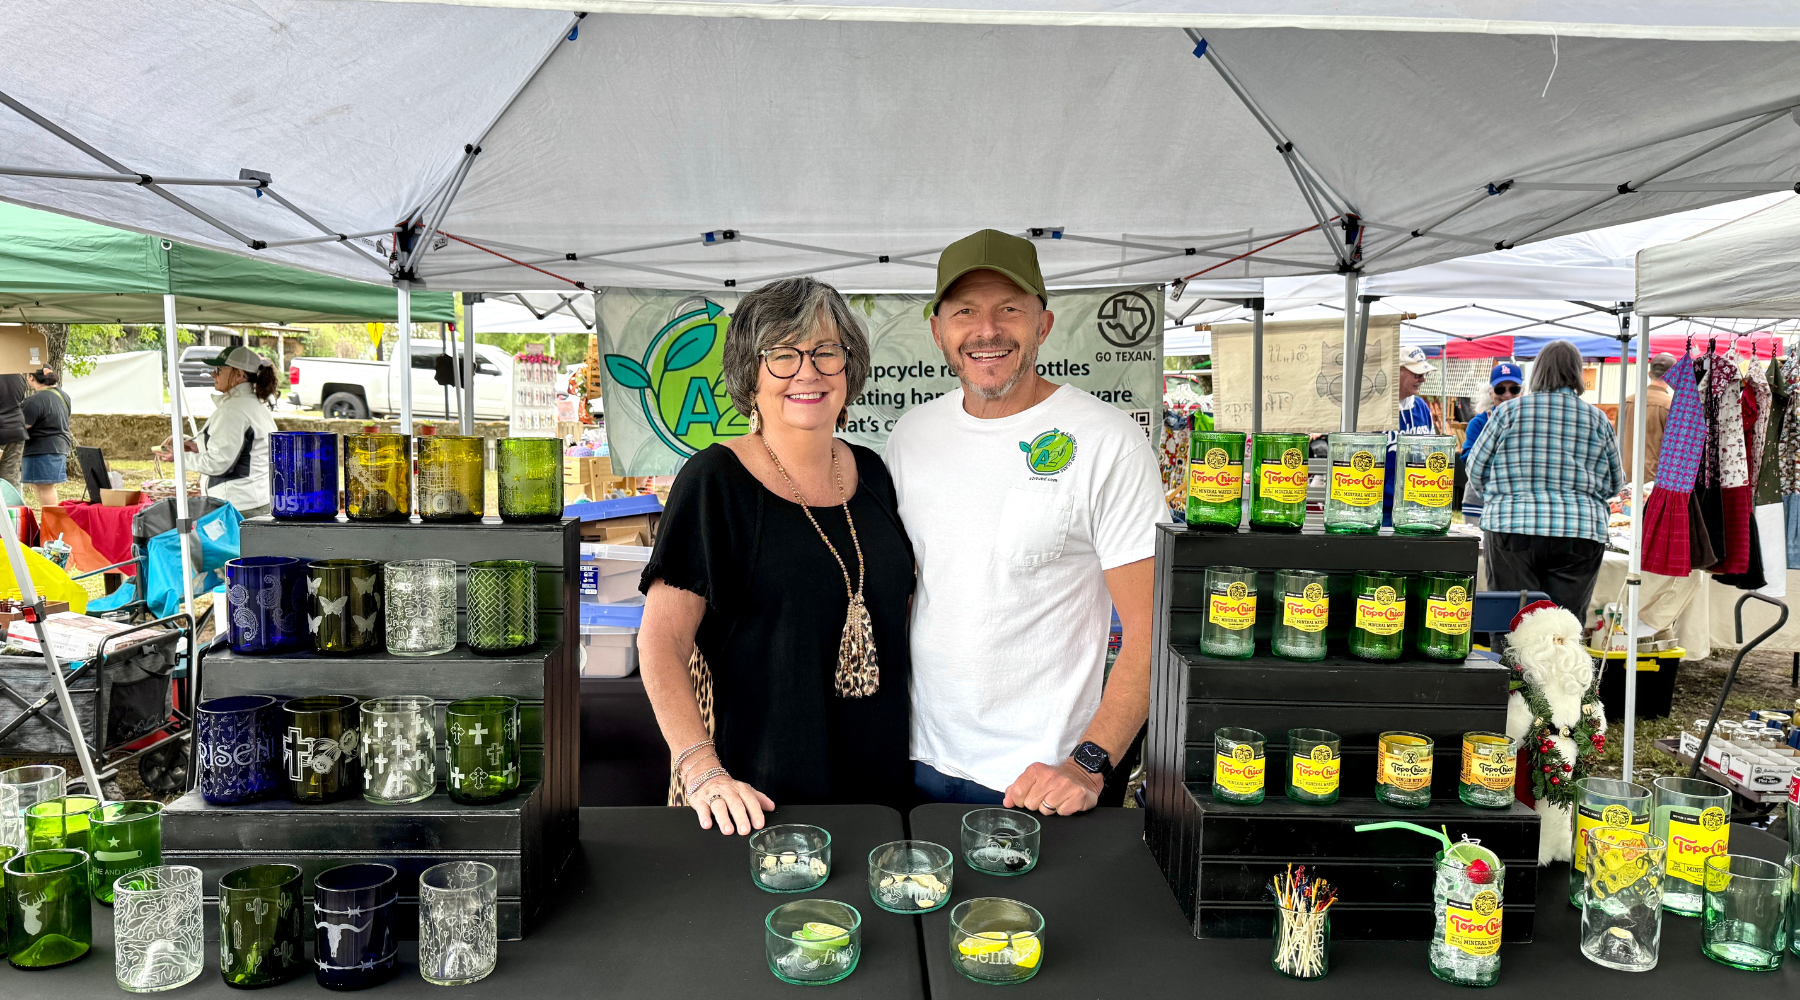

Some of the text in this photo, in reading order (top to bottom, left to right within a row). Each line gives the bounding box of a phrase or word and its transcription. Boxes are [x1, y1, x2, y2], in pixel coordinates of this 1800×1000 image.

[1095, 350, 1156, 362] GO TEXAN.
[1035, 358, 1090, 376] ottles
[851, 388, 905, 409] ating
[1192, 470, 1214, 484] Topo
[1264, 470, 1290, 484] Topo
[1334, 472, 1360, 487] Topo
[1408, 474, 1435, 488] Topo
[1212, 600, 1236, 613] Topo
[1287, 602, 1311, 615] Topo
[1359, 604, 1384, 618] Topo
[1430, 605, 1455, 618] Topo
[1219, 760, 1242, 775] Topo
[1296, 763, 1321, 776] Topo
[1391, 762, 1410, 772] Topo
[1479, 763, 1499, 773] Topo
[1673, 835, 1728, 857] Topo Chic
[105, 868, 120, 876] AND
[1450, 914, 1485, 933] Topo
[820, 943, 855, 966] Limes
